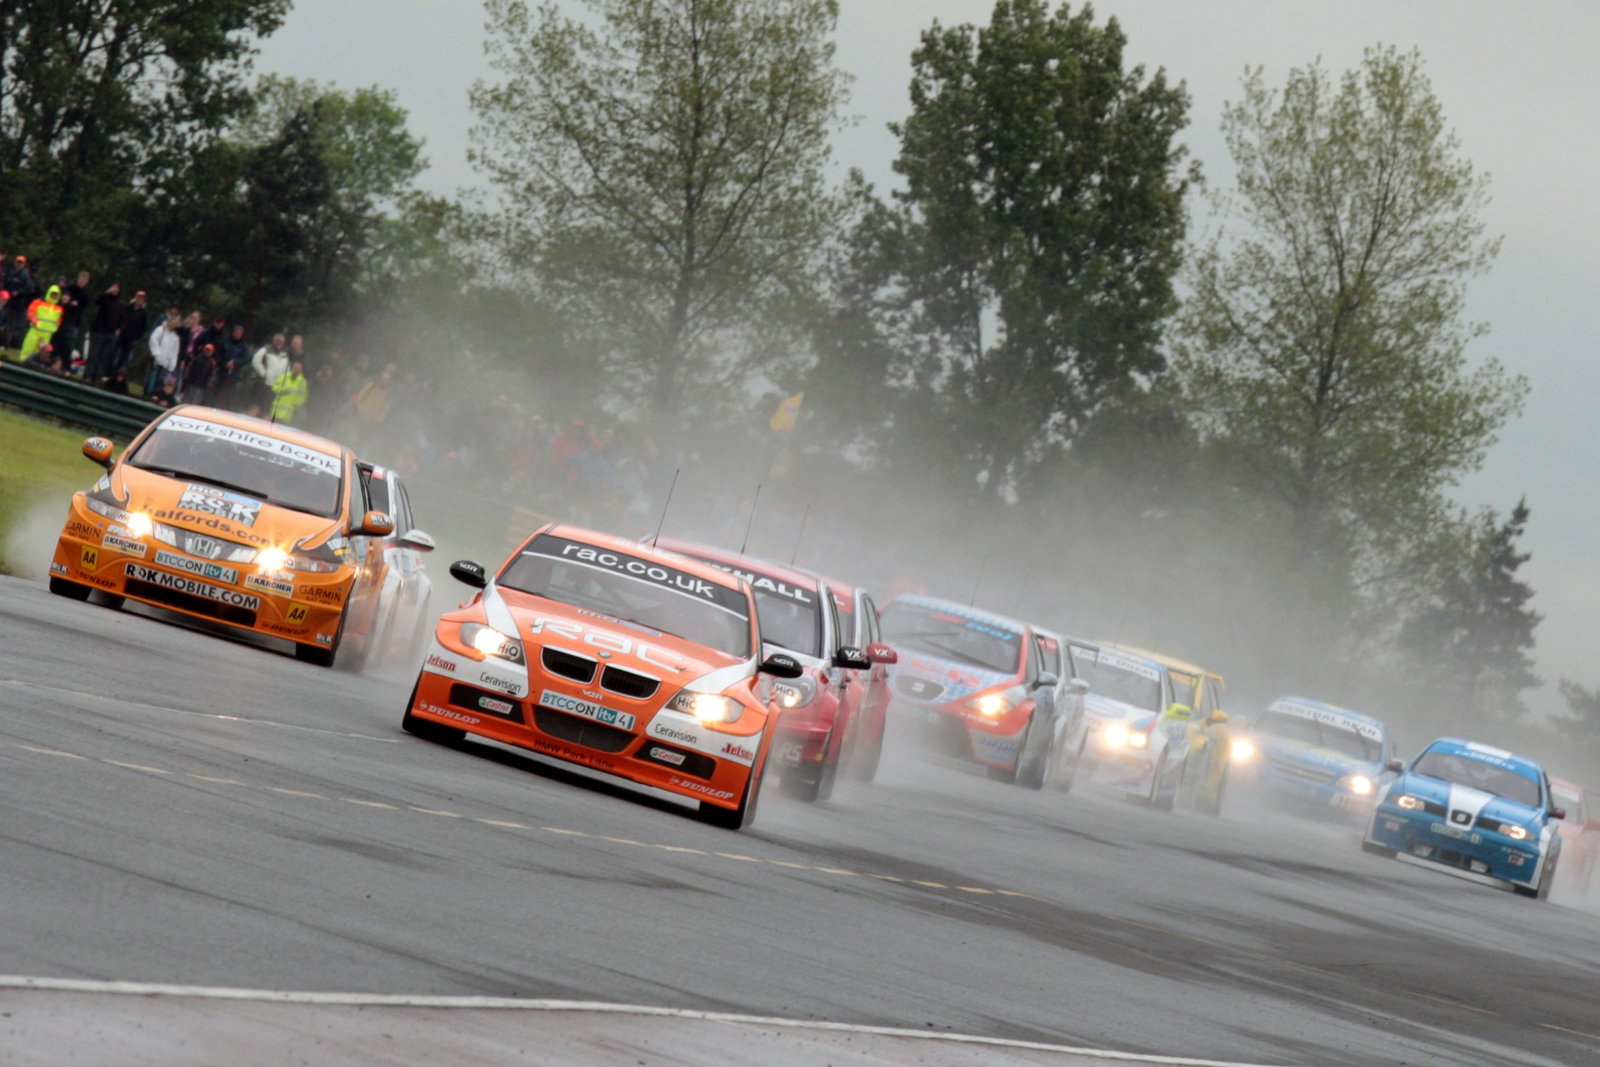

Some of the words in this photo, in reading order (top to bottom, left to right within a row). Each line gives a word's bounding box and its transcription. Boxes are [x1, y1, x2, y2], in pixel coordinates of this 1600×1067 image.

[168, 418, 273, 448] Yorkshire
[279, 444, 337, 472] Bank
[83, 551, 96, 566] AA
[562, 544, 714, 599] rac.co.uk
[299, 584, 341, 601] GARMIN
[288, 608, 306, 621] AA
[498, 644, 519, 658] HiQ
[845, 650, 862, 658] VX
[875, 648, 889, 657] VX
[480, 671, 521, 692] Ceravision
[427, 704, 480, 724] DUNLOP
[654, 723, 698, 744] Ceravision
[679, 780, 735, 799] DUNLOP
